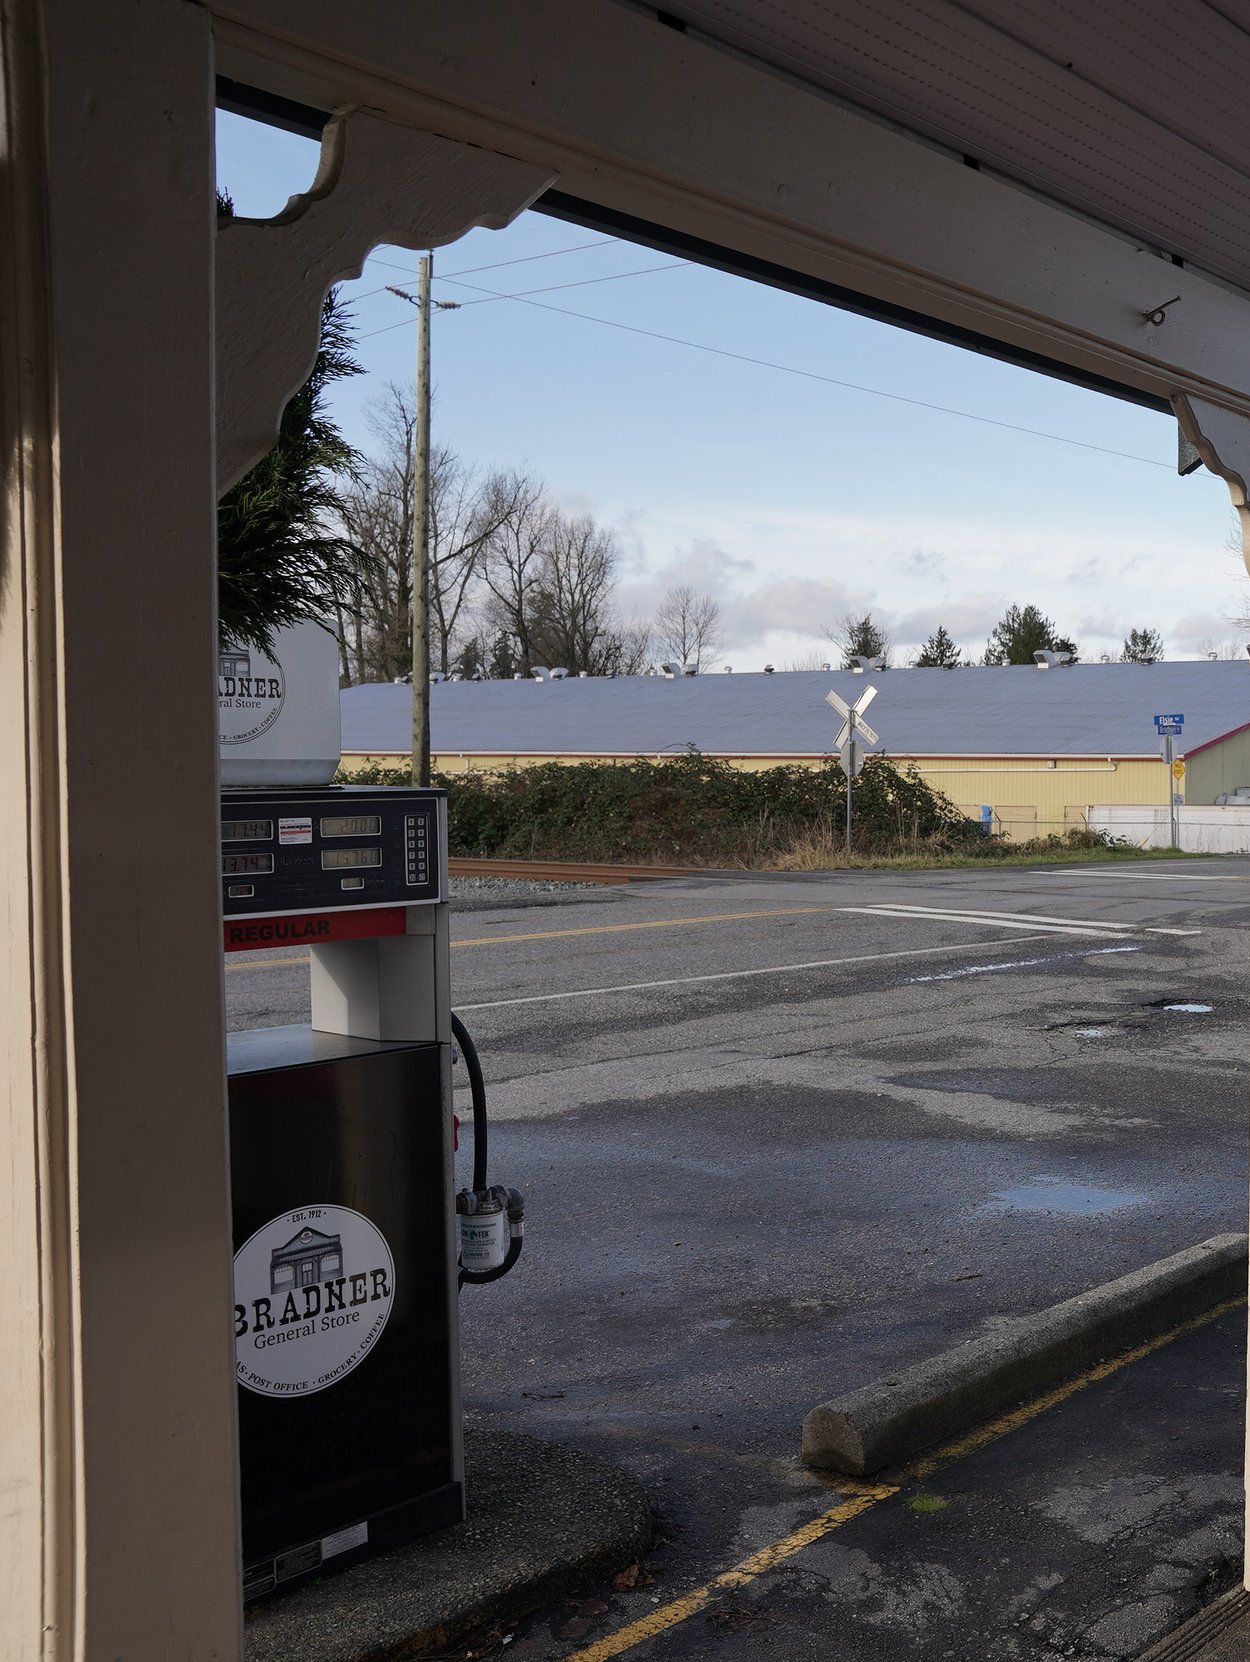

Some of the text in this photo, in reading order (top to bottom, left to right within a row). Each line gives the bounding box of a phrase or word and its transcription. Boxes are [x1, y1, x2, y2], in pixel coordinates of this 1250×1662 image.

[219, 677, 282, 698] DNER
[236, 699, 261, 708] Store
[230, 920, 330, 944] REGULAR
[292, 1210, 322, 1223] EST. 1912
[254, 1310, 360, 1350] General Store
[248, 1312, 385, 1390] POST OFFICE GROCERY COFFEE
